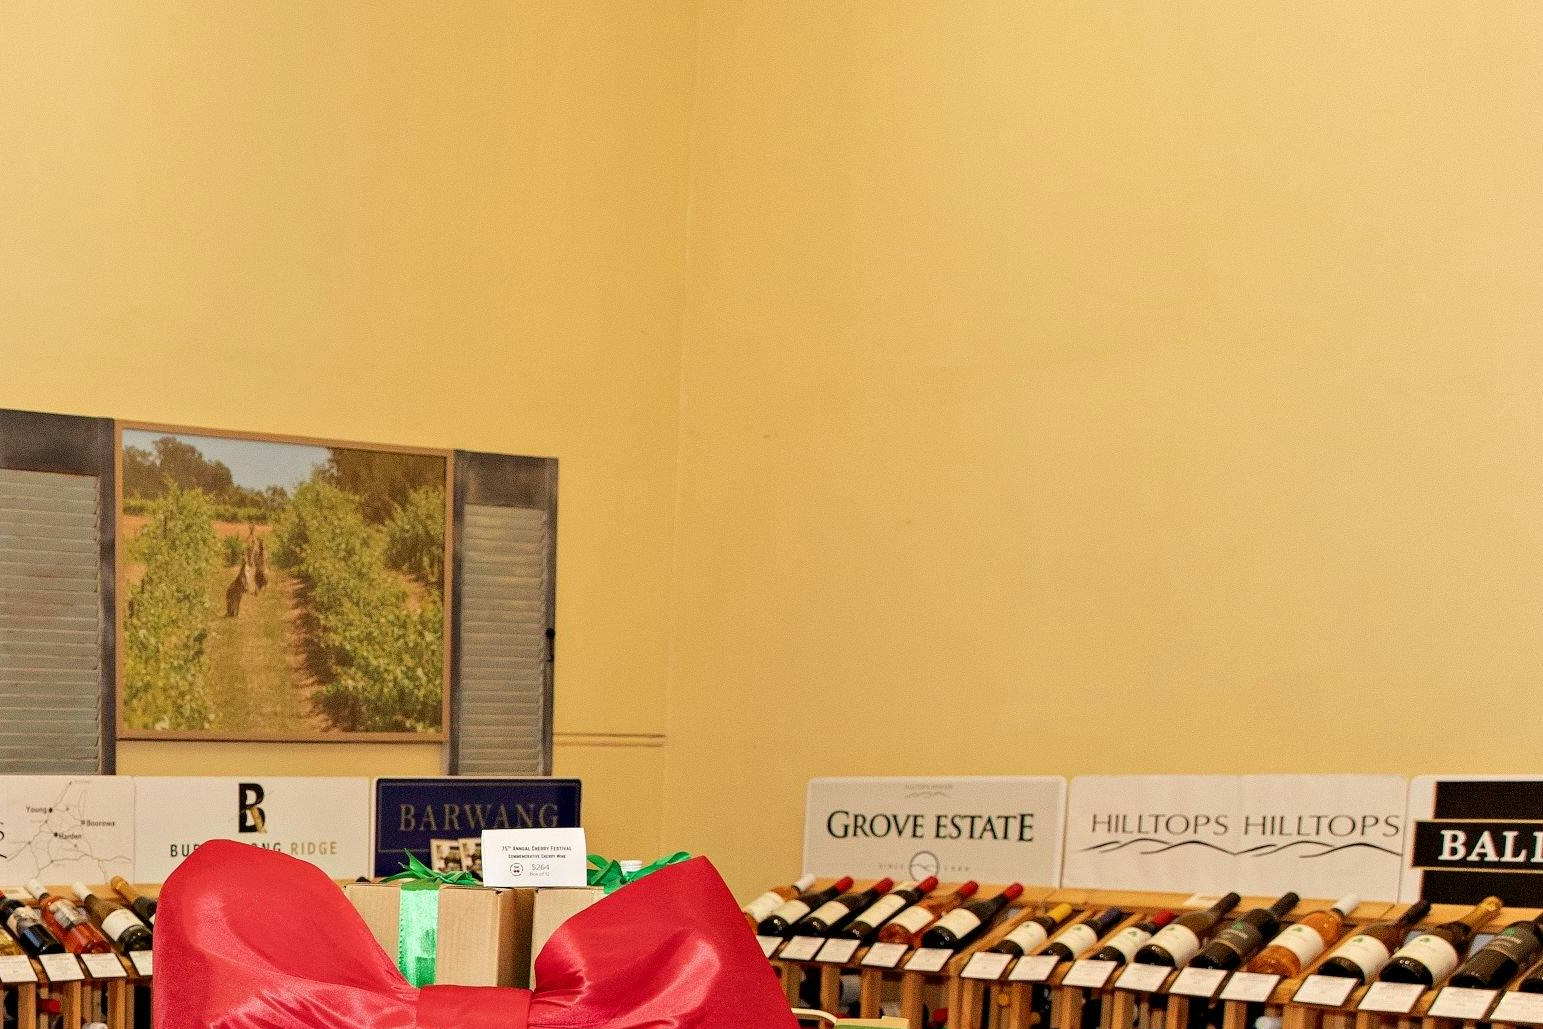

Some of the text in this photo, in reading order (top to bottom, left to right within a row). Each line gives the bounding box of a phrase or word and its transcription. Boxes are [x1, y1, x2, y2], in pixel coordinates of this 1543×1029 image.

[25, 806, 48, 815] Young
[398, 802, 560, 832] BARWANG
[86, 819, 116, 828] Boorowa
[827, 810, 1035, 843] GROVE ESTATE
[1091, 813, 1229, 836] HILLTOPS
[1244, 815, 1401, 838] HILLTOPS
[58, 832, 82, 841] Harden
[289, 841, 339, 856] RIDGE
